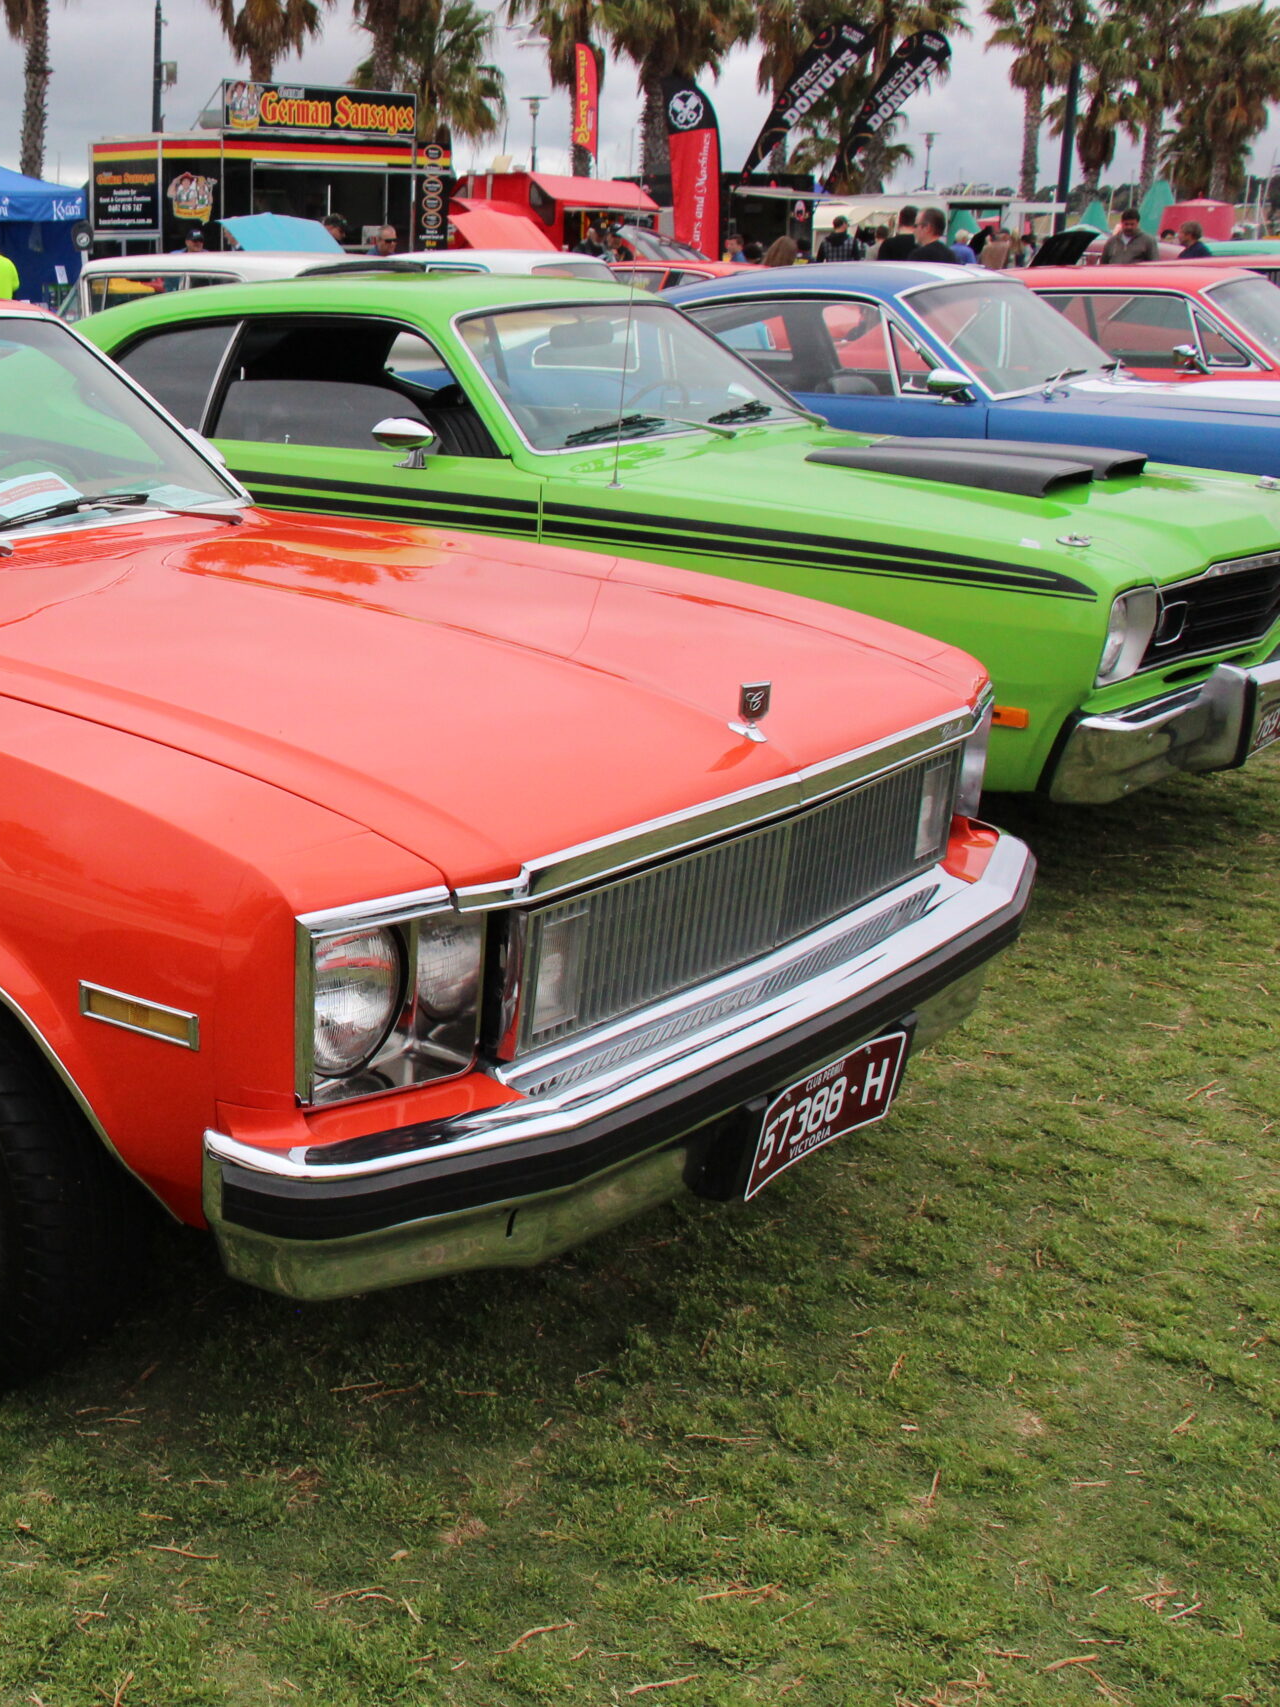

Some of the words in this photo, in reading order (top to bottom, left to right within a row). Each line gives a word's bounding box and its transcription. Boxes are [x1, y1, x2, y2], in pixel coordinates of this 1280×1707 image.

[782, 49, 859, 126] DONUTS
[789, 53, 834, 97] FRESH
[866, 56, 939, 132] DONUTS
[874, 61, 914, 103] FRESH
[260, 91, 331, 127] German
[333, 95, 415, 136] Sausages
[695, 132, 712, 194] Machines
[694, 195, 705, 219] and
[688, 222, 703, 252] Cars
[805, 1075, 824, 1092] CLUB
[822, 1060, 846, 1084] PERMIT
[789, 1125, 831, 1159] VICTORIA
